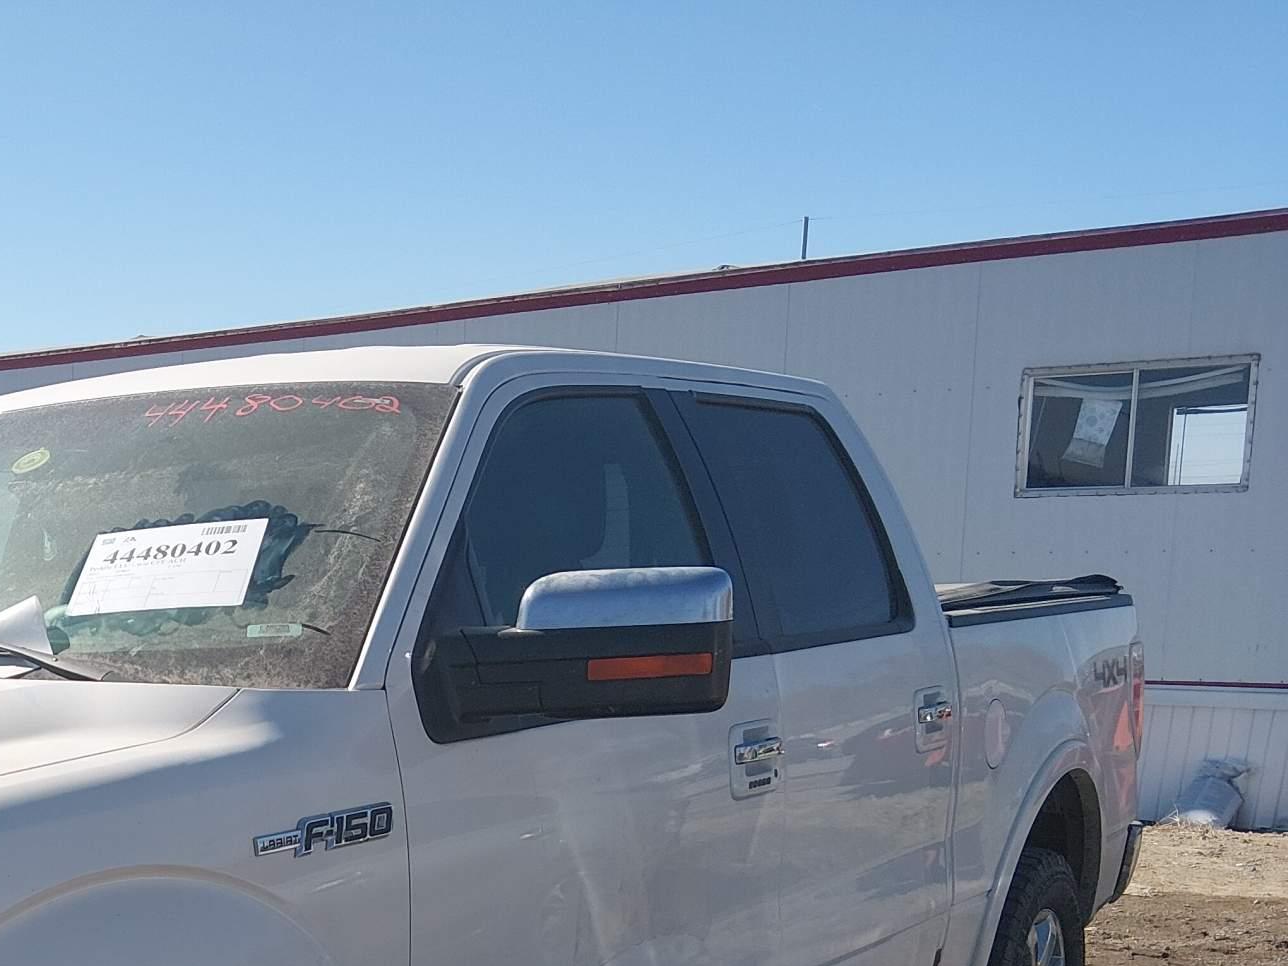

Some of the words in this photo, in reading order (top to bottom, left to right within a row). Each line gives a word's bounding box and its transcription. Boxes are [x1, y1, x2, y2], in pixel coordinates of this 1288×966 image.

[103, 538, 239, 565] 44480402
[262, 833, 300, 851] LARIAT
[300, 803, 394, 854] F-150
